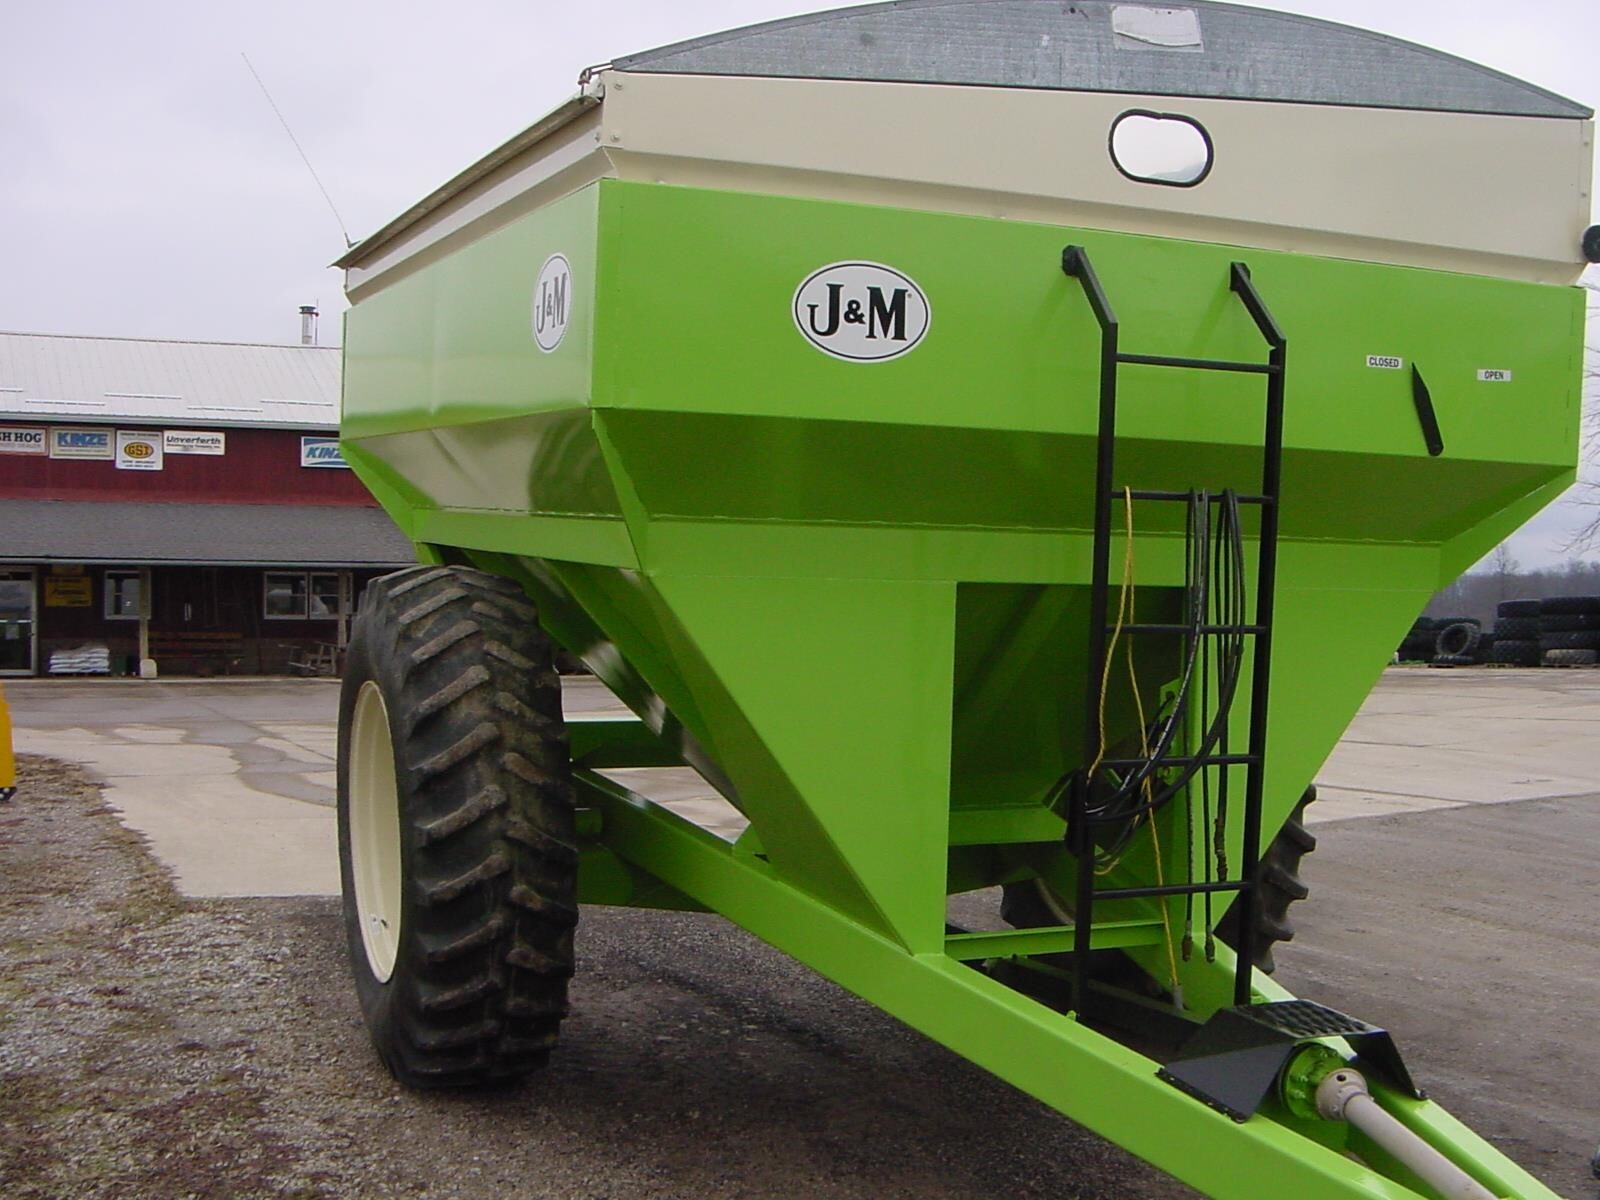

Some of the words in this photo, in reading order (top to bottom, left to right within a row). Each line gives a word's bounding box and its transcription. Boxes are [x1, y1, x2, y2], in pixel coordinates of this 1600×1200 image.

[536, 272, 567, 334] J&M
[807, 283, 909, 341] J&M
[1368, 356, 1400, 368] CLOSED
[1483, 370, 1504, 380] OPEN
[14, 432, 42, 443] HOG
[57, 432, 108, 447] KINZE
[166, 435, 221, 445] Unverferth
[128, 444, 149, 456] GSI
